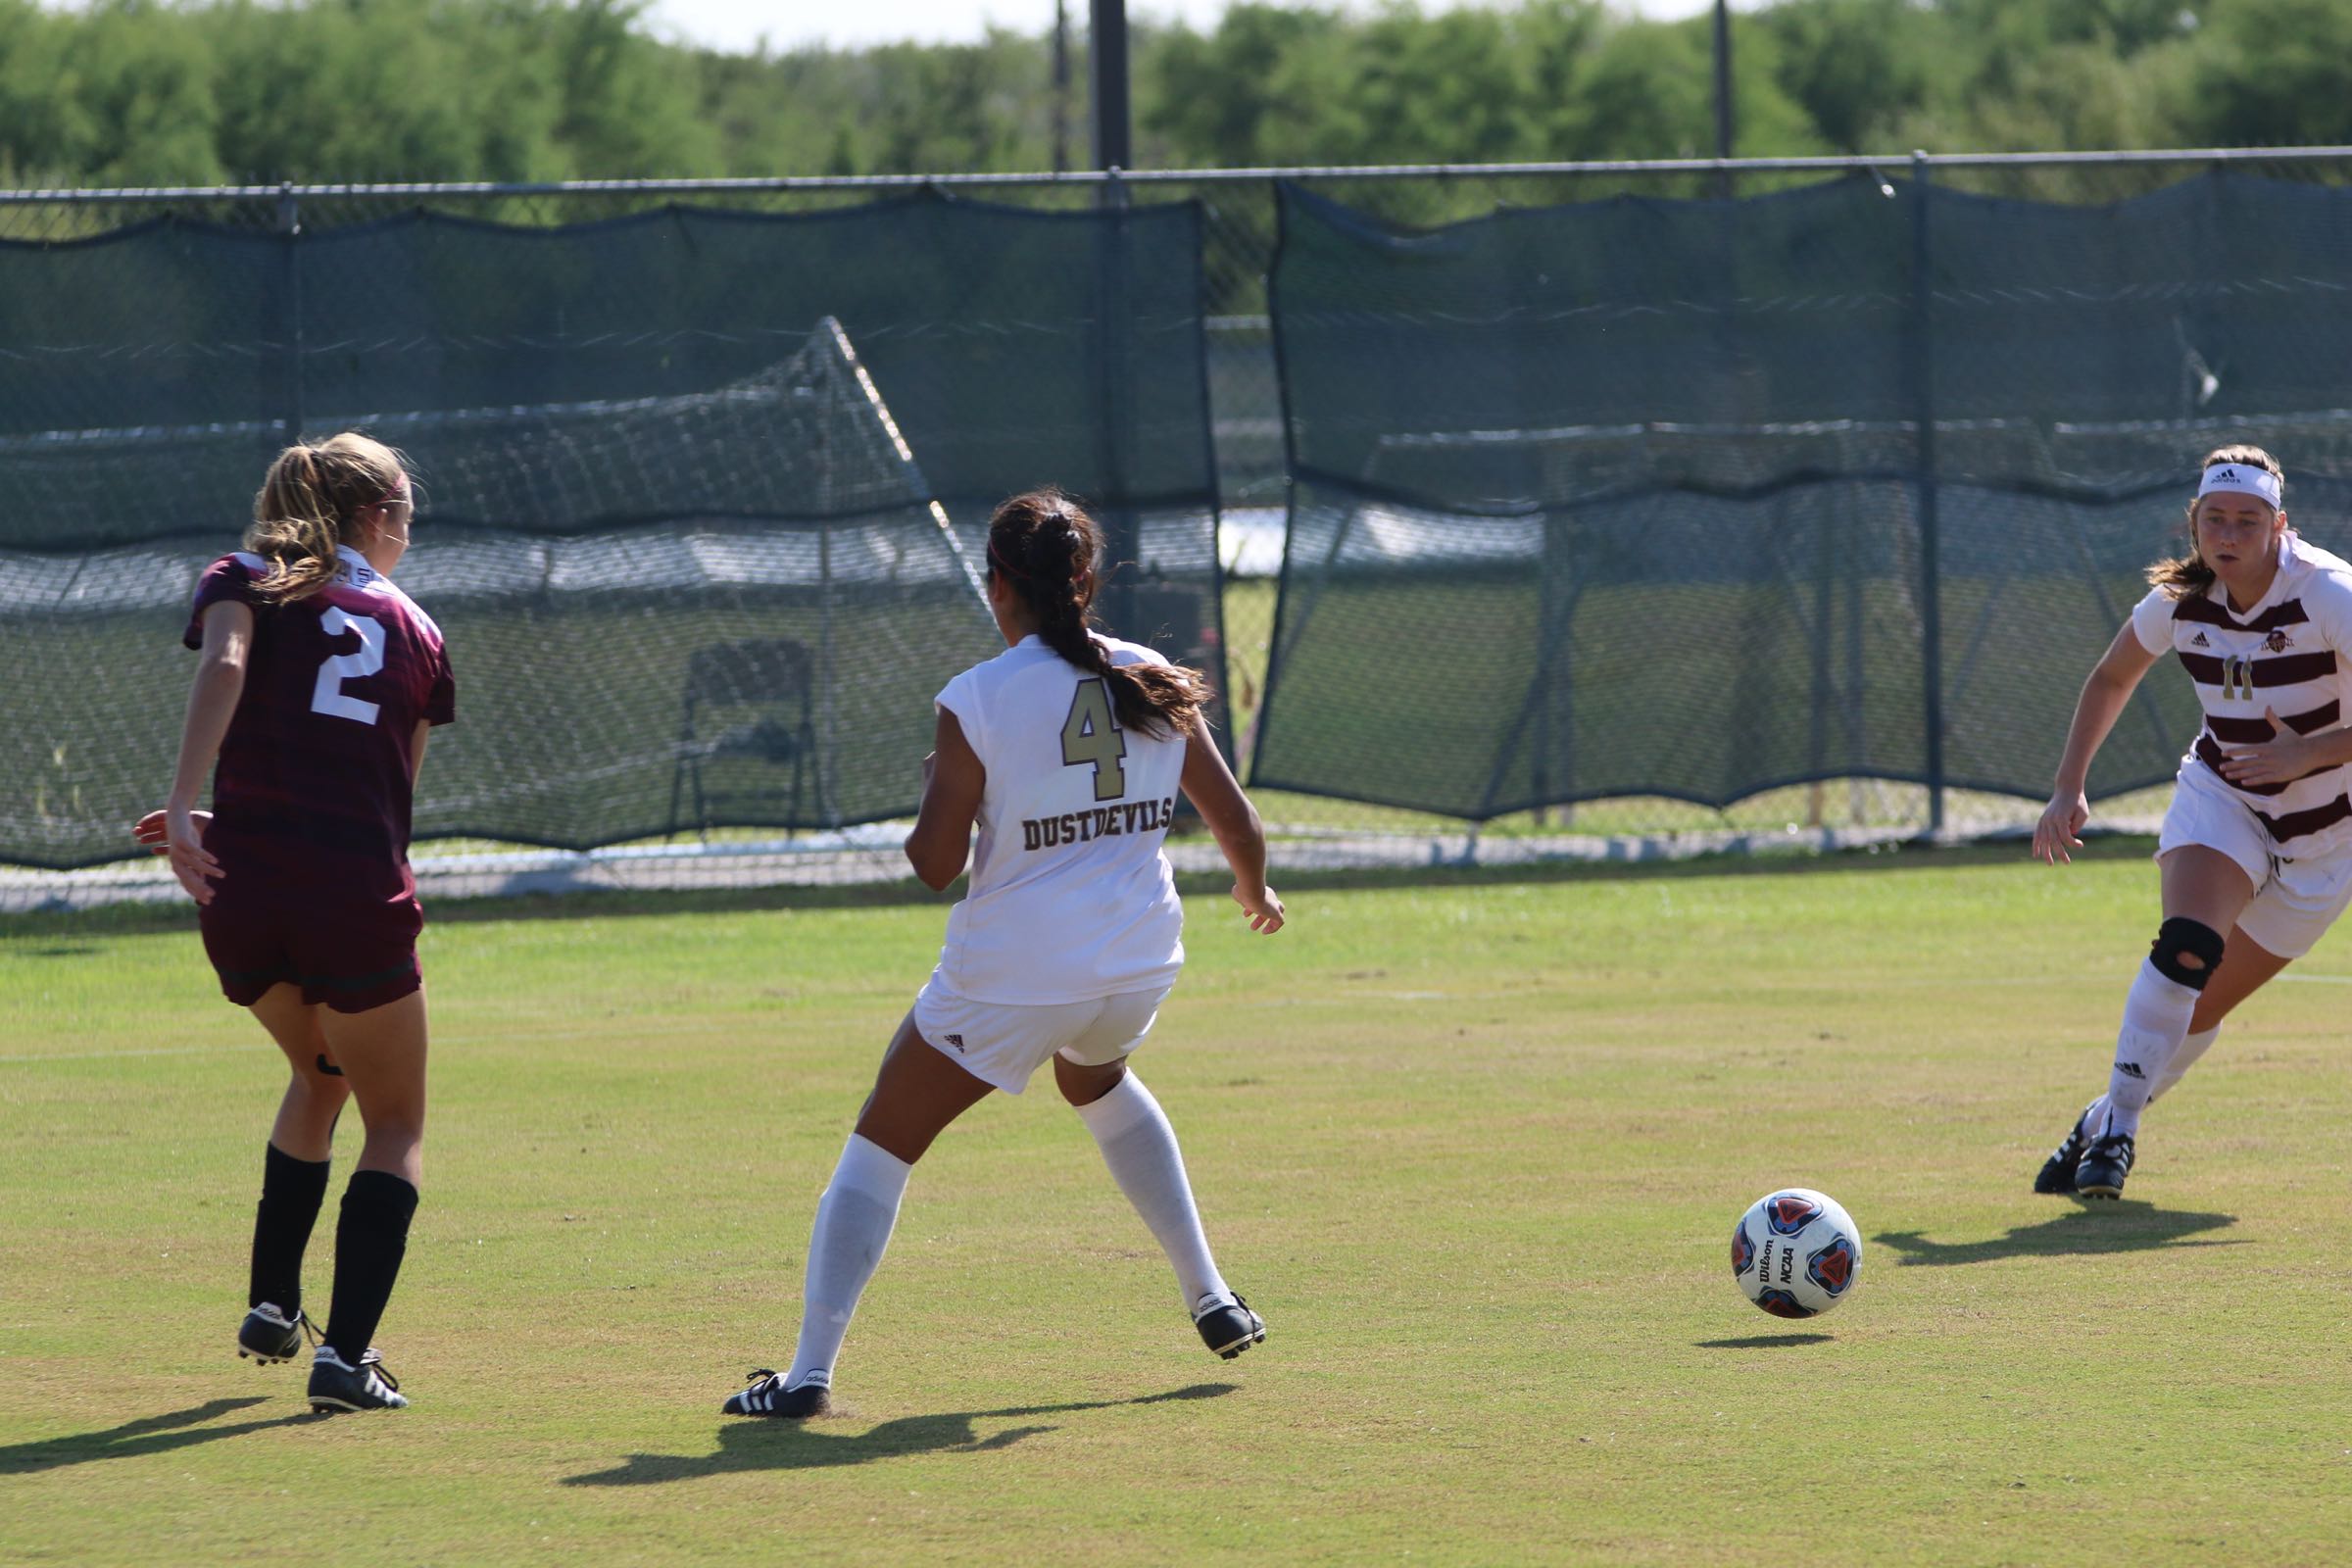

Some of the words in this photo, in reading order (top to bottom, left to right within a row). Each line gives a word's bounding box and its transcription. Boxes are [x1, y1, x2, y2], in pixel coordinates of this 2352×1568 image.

[311, 606, 386, 725] 2
[2223, 654, 2253, 701] 11
[1060, 677, 1126, 802] 4
[1022, 798, 1172, 851] DUSTDEVILS
[1760, 1239, 1774, 1282] Wilson
[1781, 1248, 1793, 1284] NCAA
